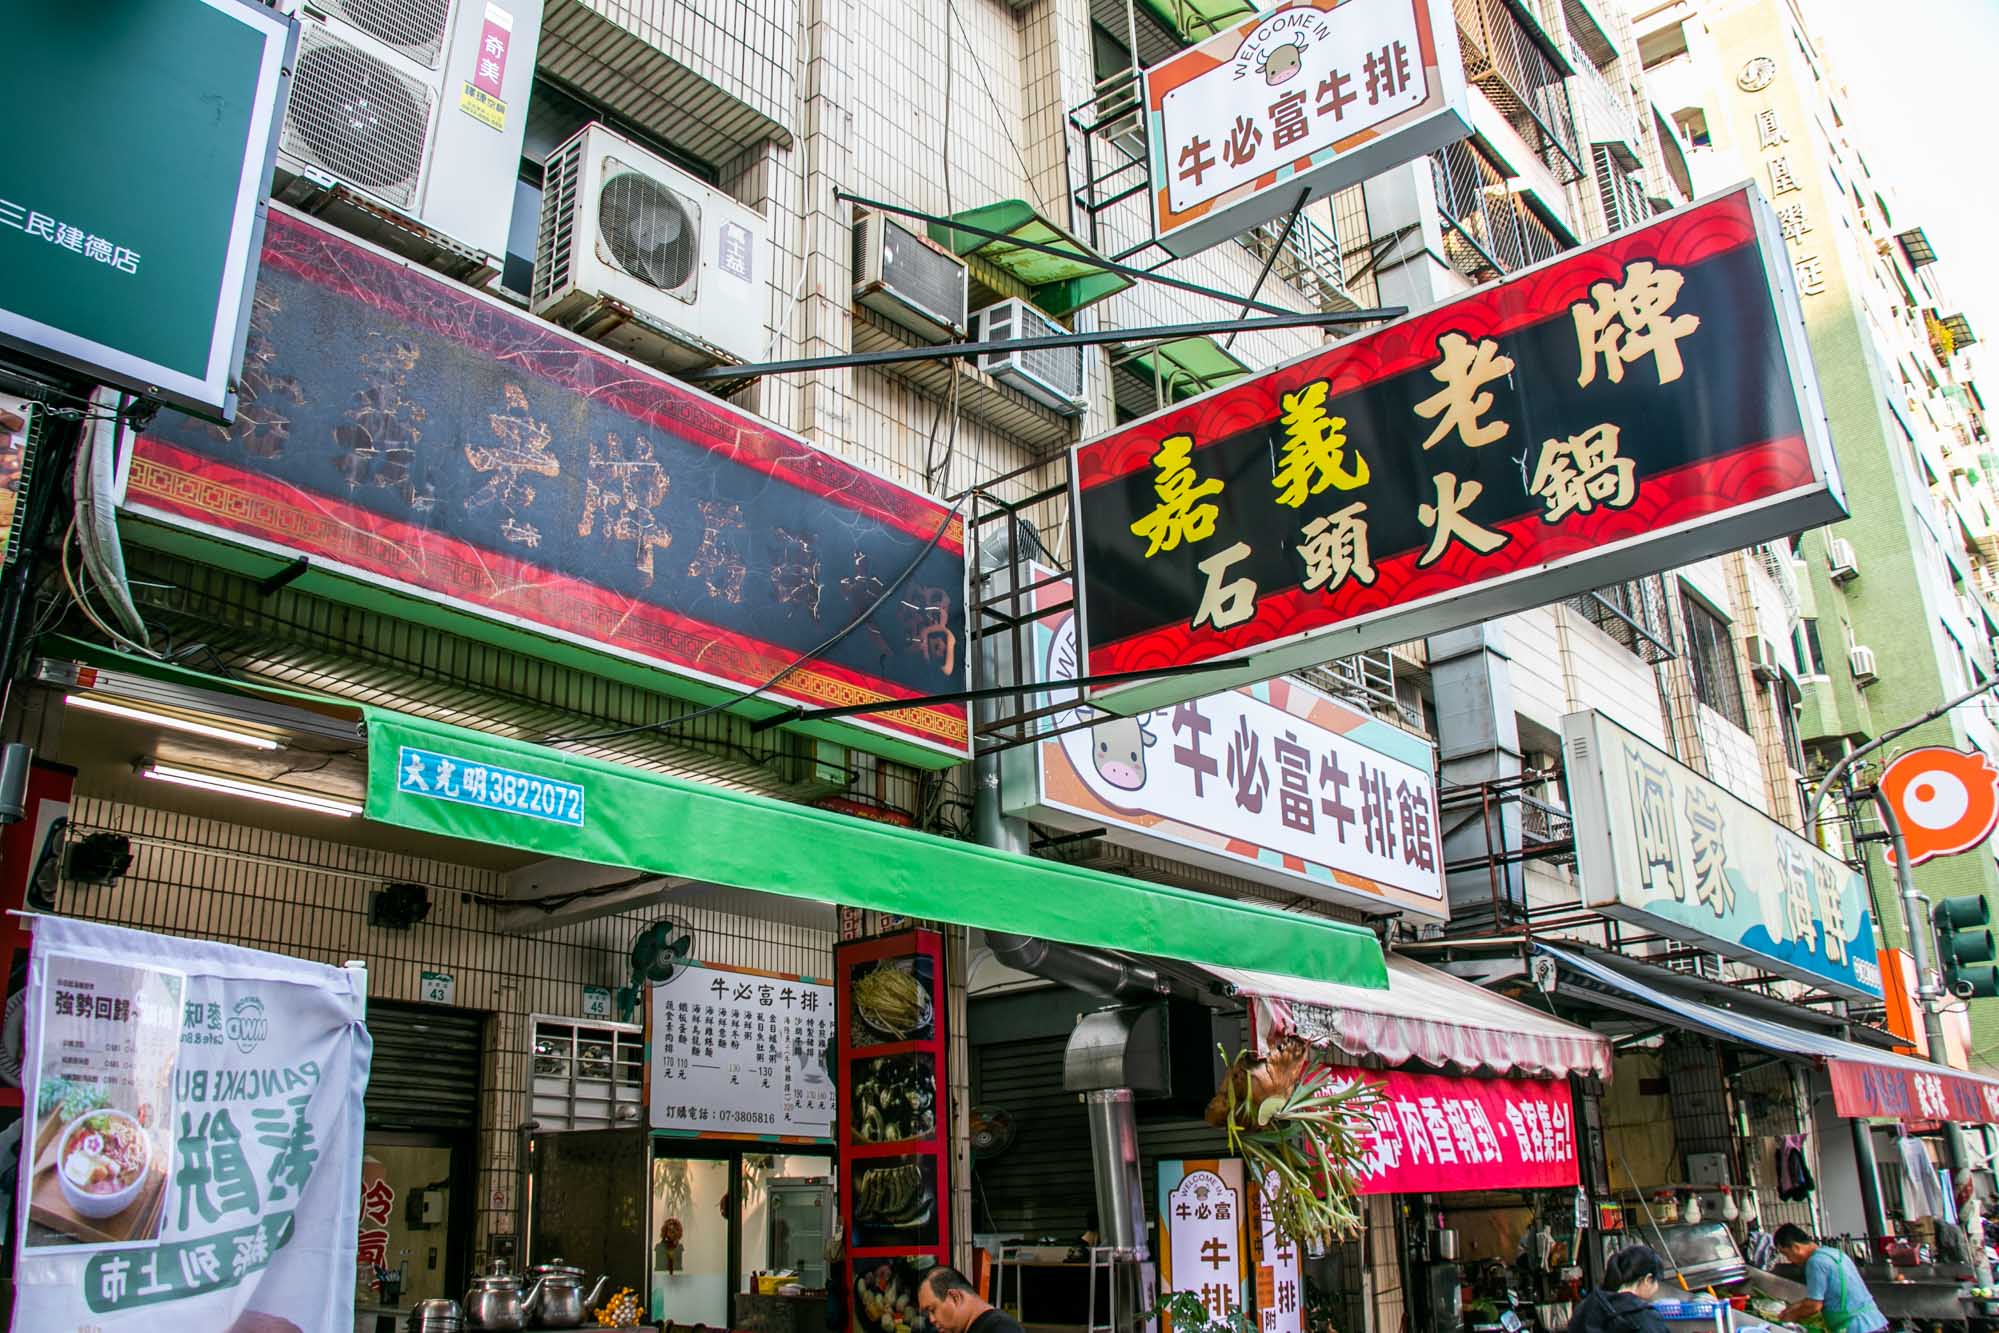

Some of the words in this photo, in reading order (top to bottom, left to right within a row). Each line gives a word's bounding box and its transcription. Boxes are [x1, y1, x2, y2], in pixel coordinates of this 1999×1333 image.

[479, 34, 504, 85] 奇美
[1233, 13, 1316, 80] WELCOME
[1311, 21, 1331, 42] IN
[1177, 40, 1411, 187] 牛必富牛排
[0, 197, 142, 275] 三民建德店
[1130, 261, 1702, 559] 嘉義老牌
[1192, 423, 1638, 630] 石頭火鍋
[1172, 700, 1436, 874] 牛必富牛排館
[55, 990, 131, 1023] 強勢回歸
[429, 989, 445, 1002] 43
[590, 1002, 604, 1014] 45
[710, 977, 820, 1013] 牛必富牛排
[1175, 1201, 1231, 1221] 牛必富
[1181, 1173, 1218, 1197] WELCOME
[1200, 1237, 1233, 1317] 牛排
